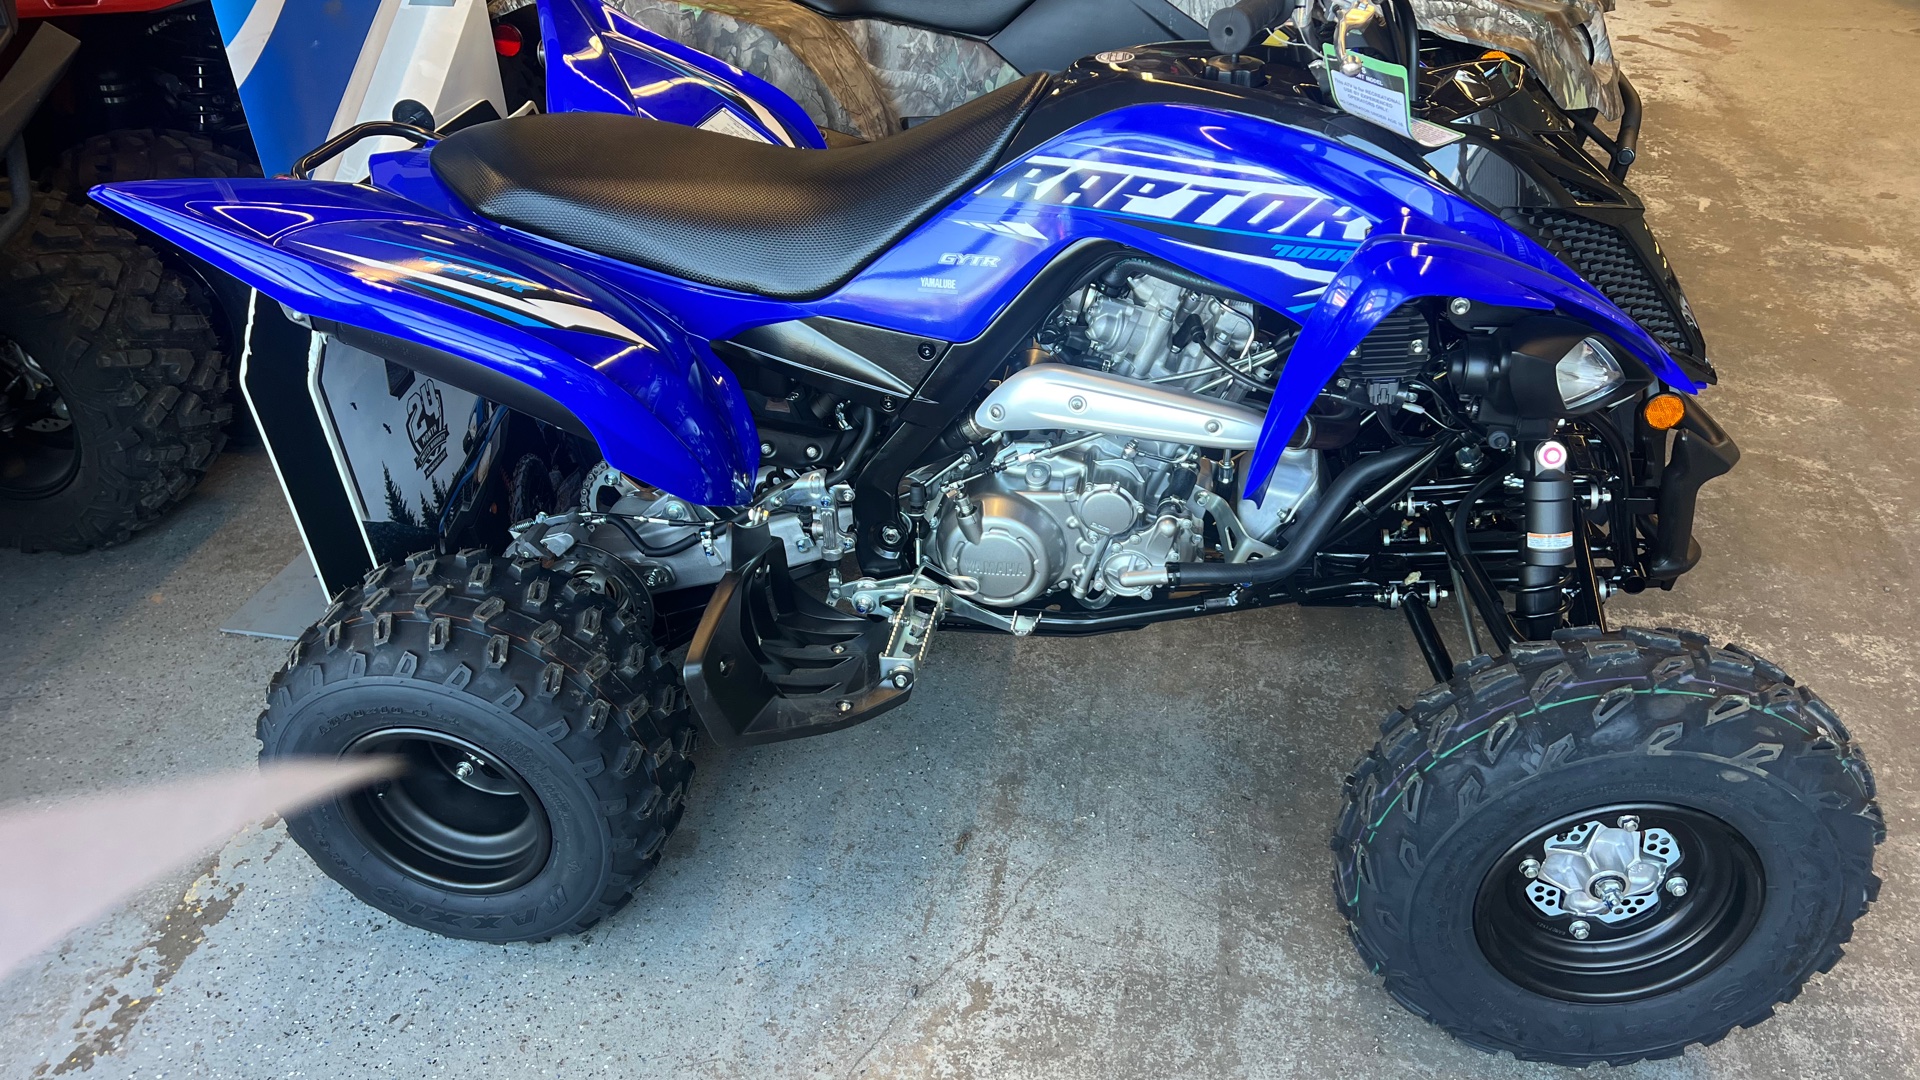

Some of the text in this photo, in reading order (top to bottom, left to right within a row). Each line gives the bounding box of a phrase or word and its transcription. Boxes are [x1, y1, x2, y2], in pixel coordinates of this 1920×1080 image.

[978, 161, 1366, 240] RAPTOR
[937, 253, 1001, 268] GYTR
[1270, 243, 1355, 262] 700R
[920, 277, 957, 290] YAMALUBE
[406, 379, 441, 442] 24
[963, 558, 1028, 578] YAMAHA
[370, 884, 568, 931] MAXXIS
